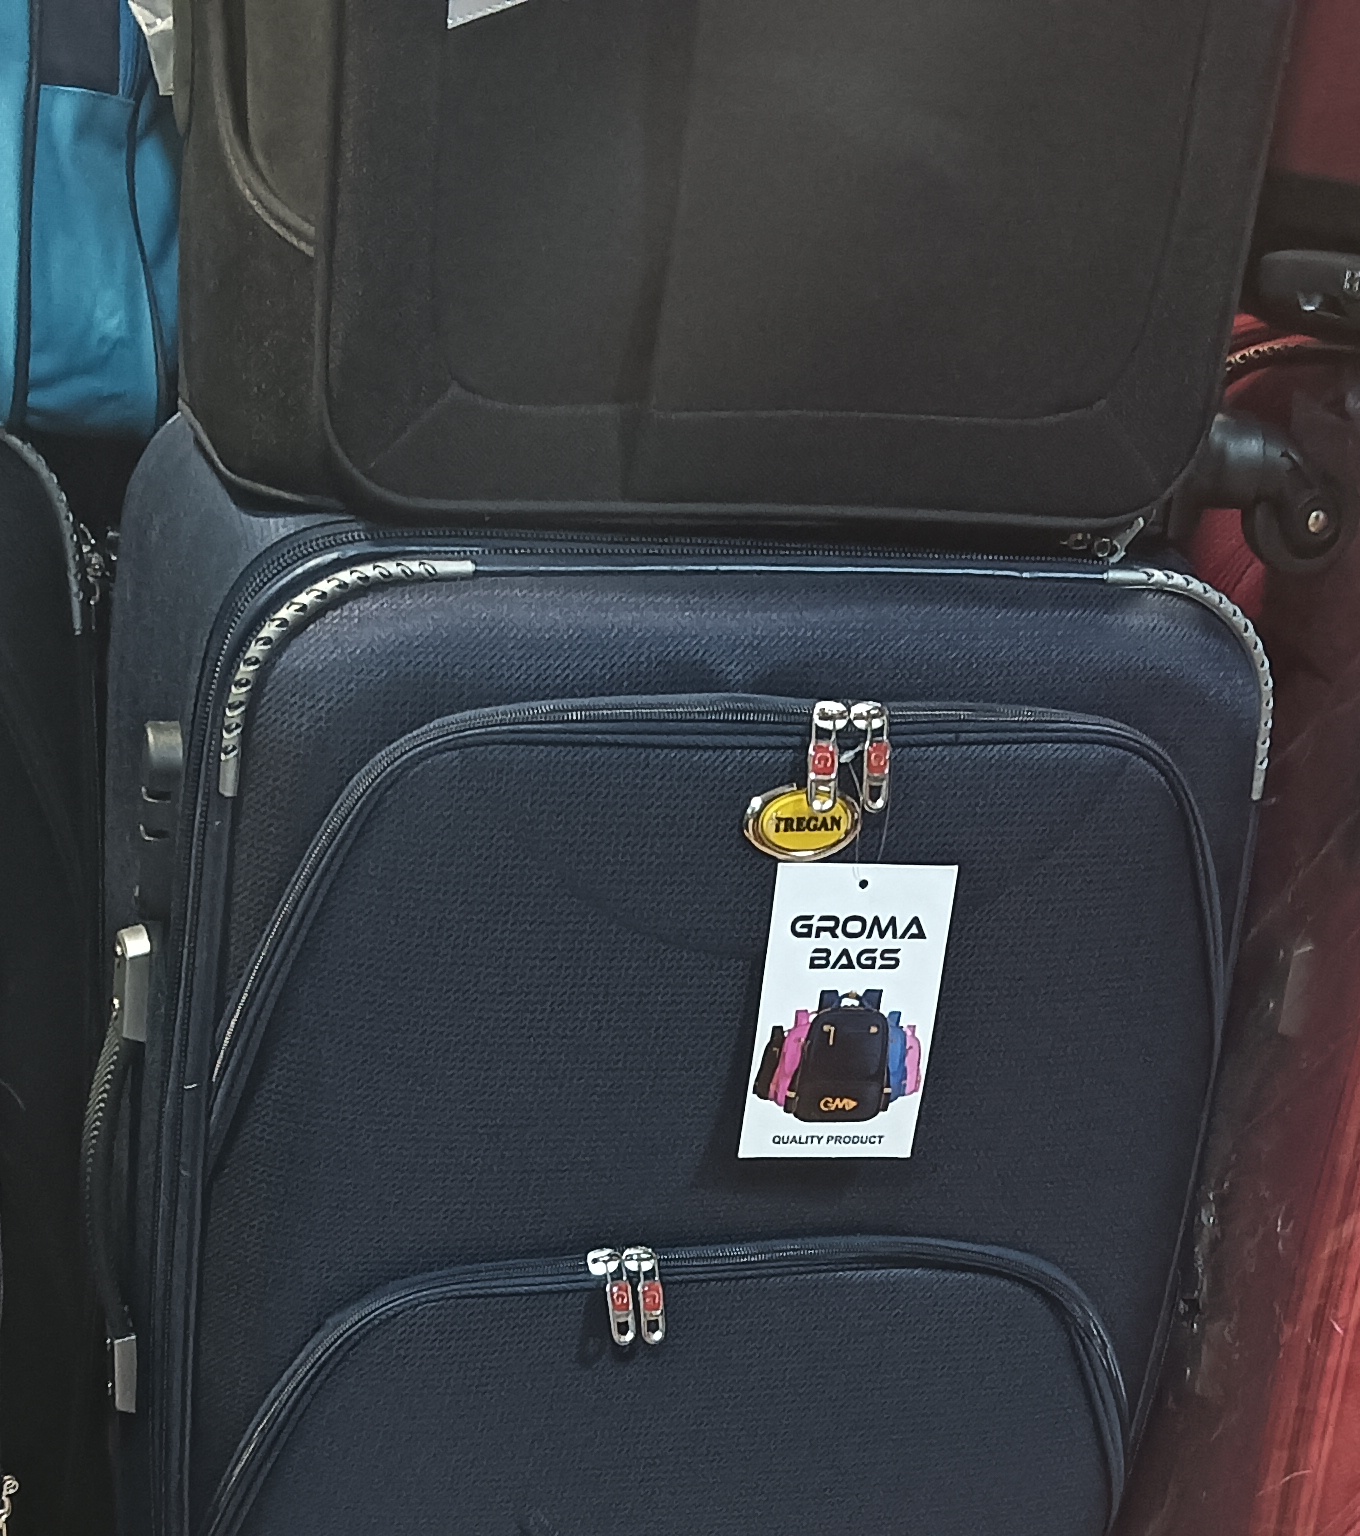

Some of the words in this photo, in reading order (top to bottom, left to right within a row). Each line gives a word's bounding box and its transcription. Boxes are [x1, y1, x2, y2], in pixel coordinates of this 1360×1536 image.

[774, 815, 842, 833] TREGAN
[790, 914, 927, 939] GROMA
[808, 947, 902, 969] BAGS
[771, 1134, 824, 1145] QUALITY
[826, 1134, 885, 1145] PRODUCT
